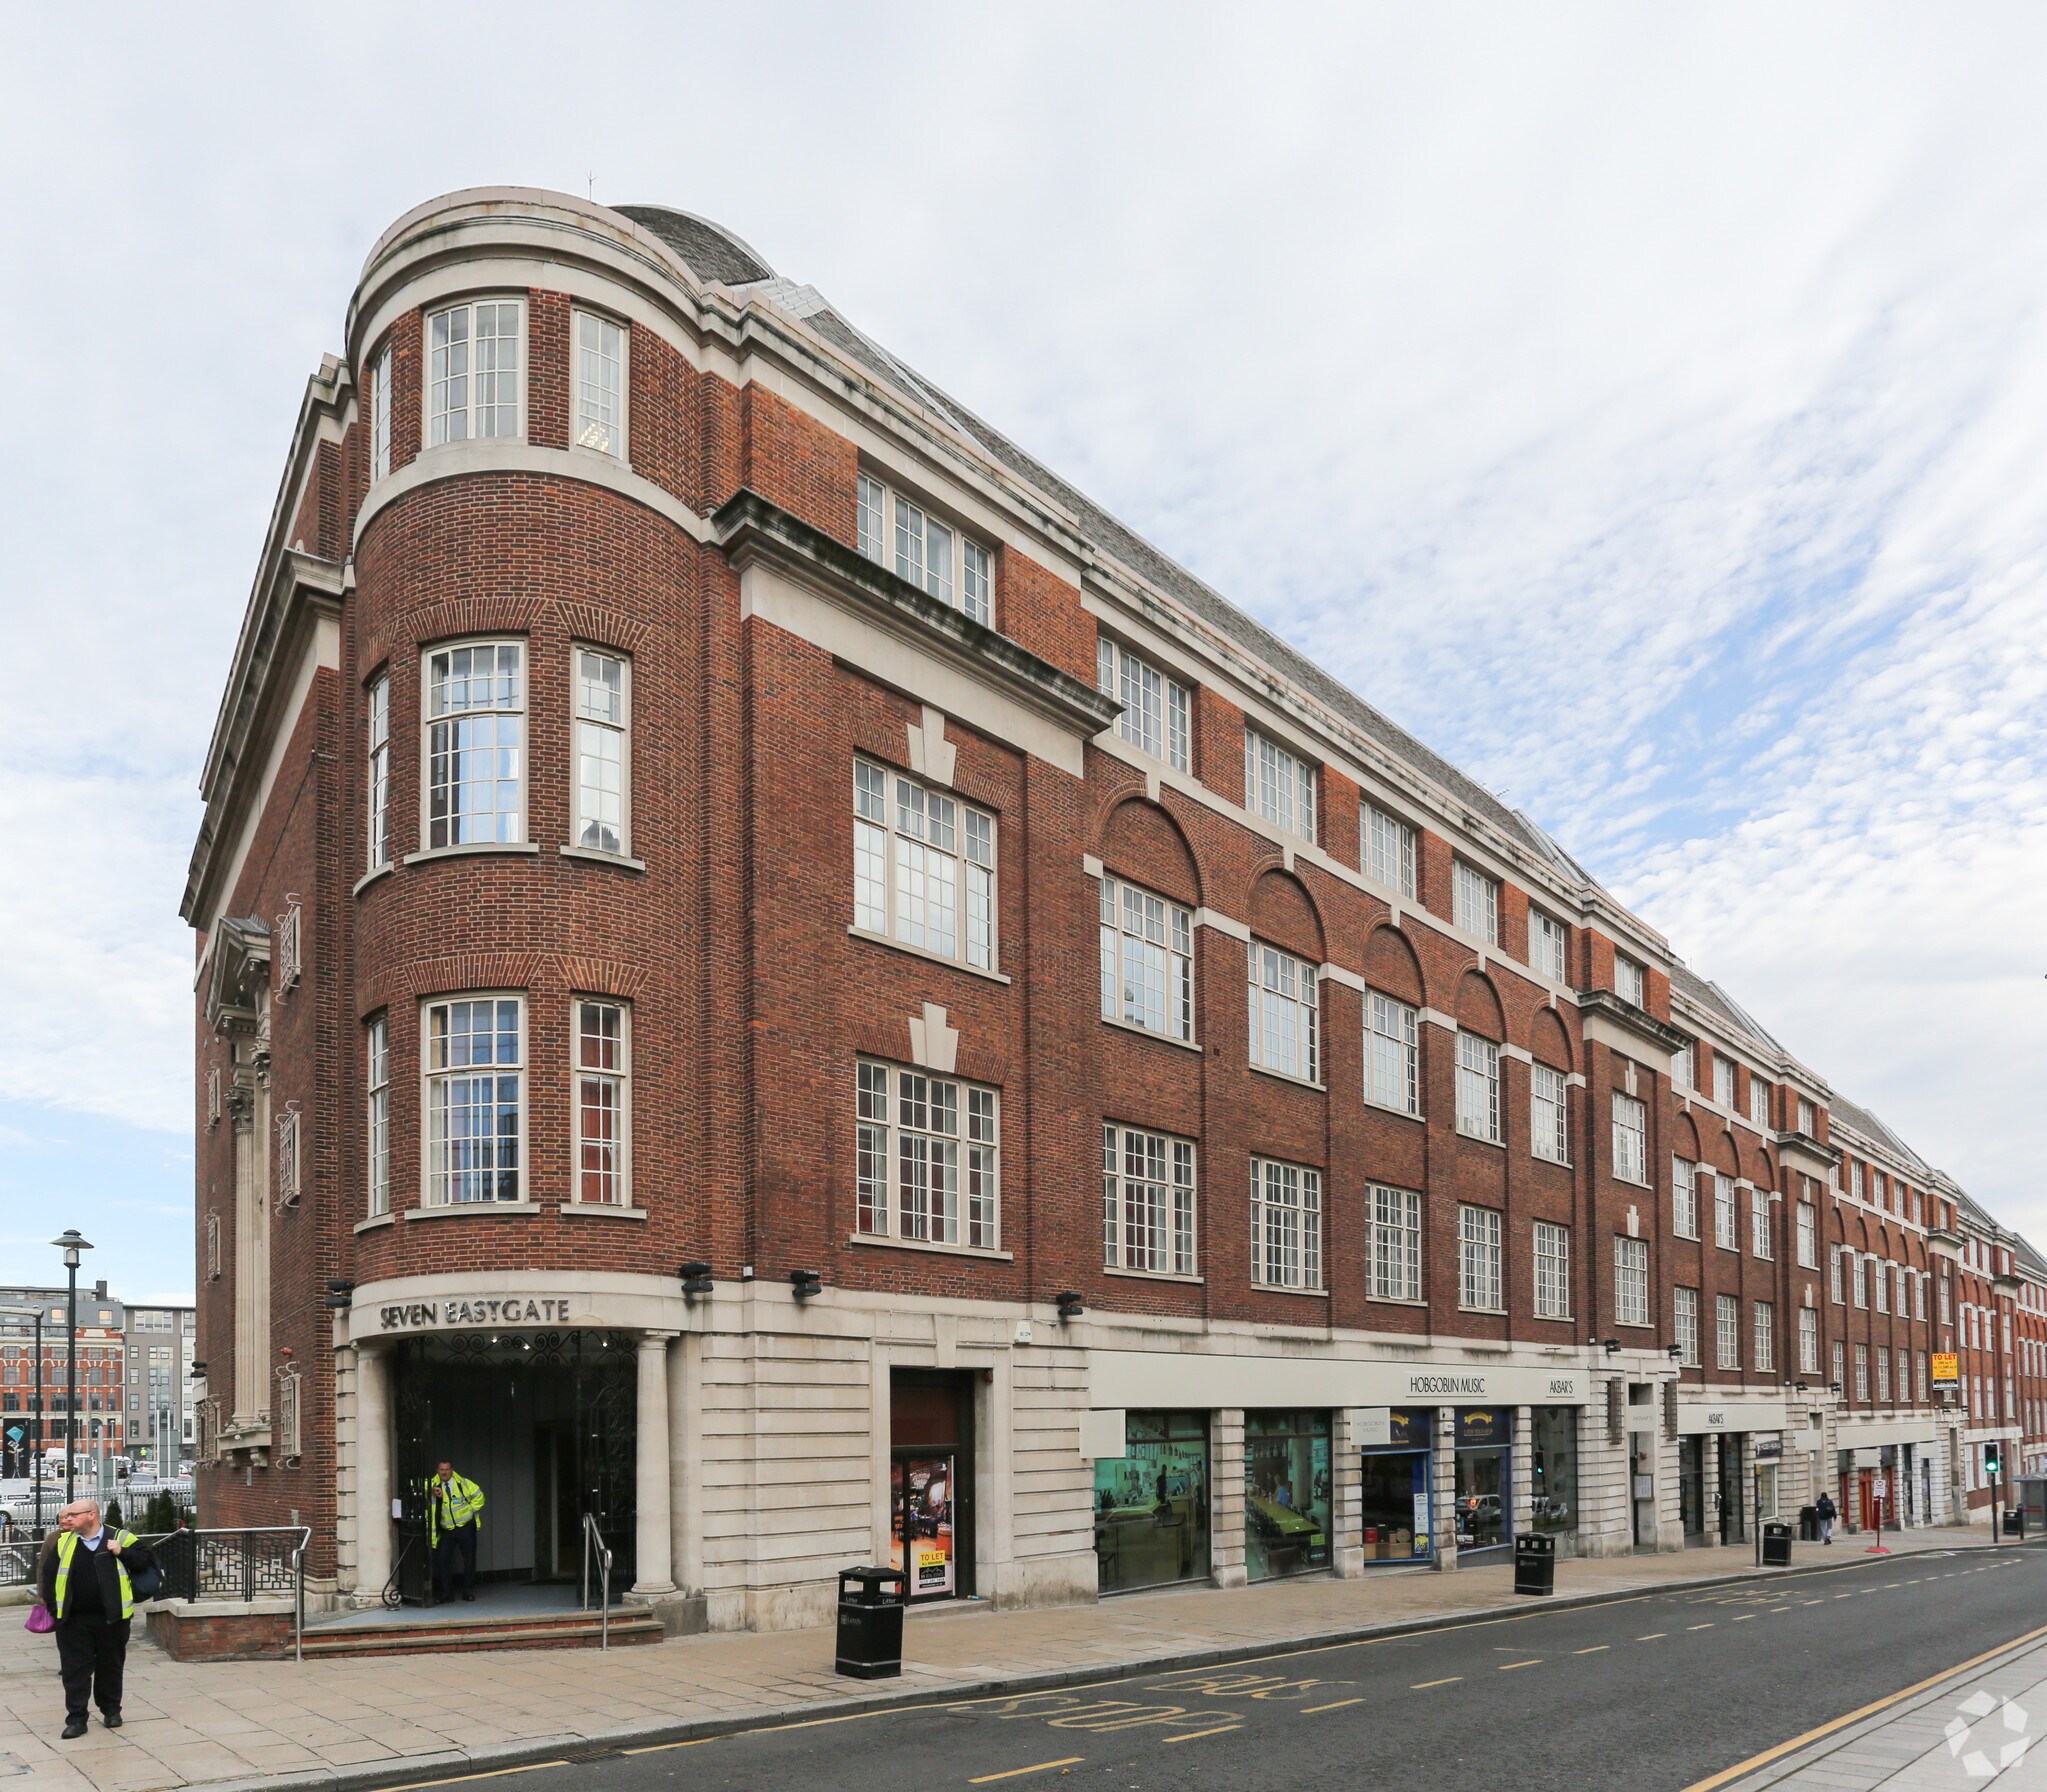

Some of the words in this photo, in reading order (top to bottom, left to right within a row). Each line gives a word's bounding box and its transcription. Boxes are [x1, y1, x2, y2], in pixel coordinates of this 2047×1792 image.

[380, 1302, 437, 1329] SEVEN
[445, 1299, 570, 1323] EASTGATE
[1410, 1376, 1459, 1393] HOBGOBLIN
[1460, 1378, 1486, 1393] MUSIC
[1549, 1380, 1574, 1394] AKBAR'S
[931, 1552, 944, 1560] LET
[1144, 1673, 1358, 1700] BUS
[947, 1696, 1245, 1733] STOP
